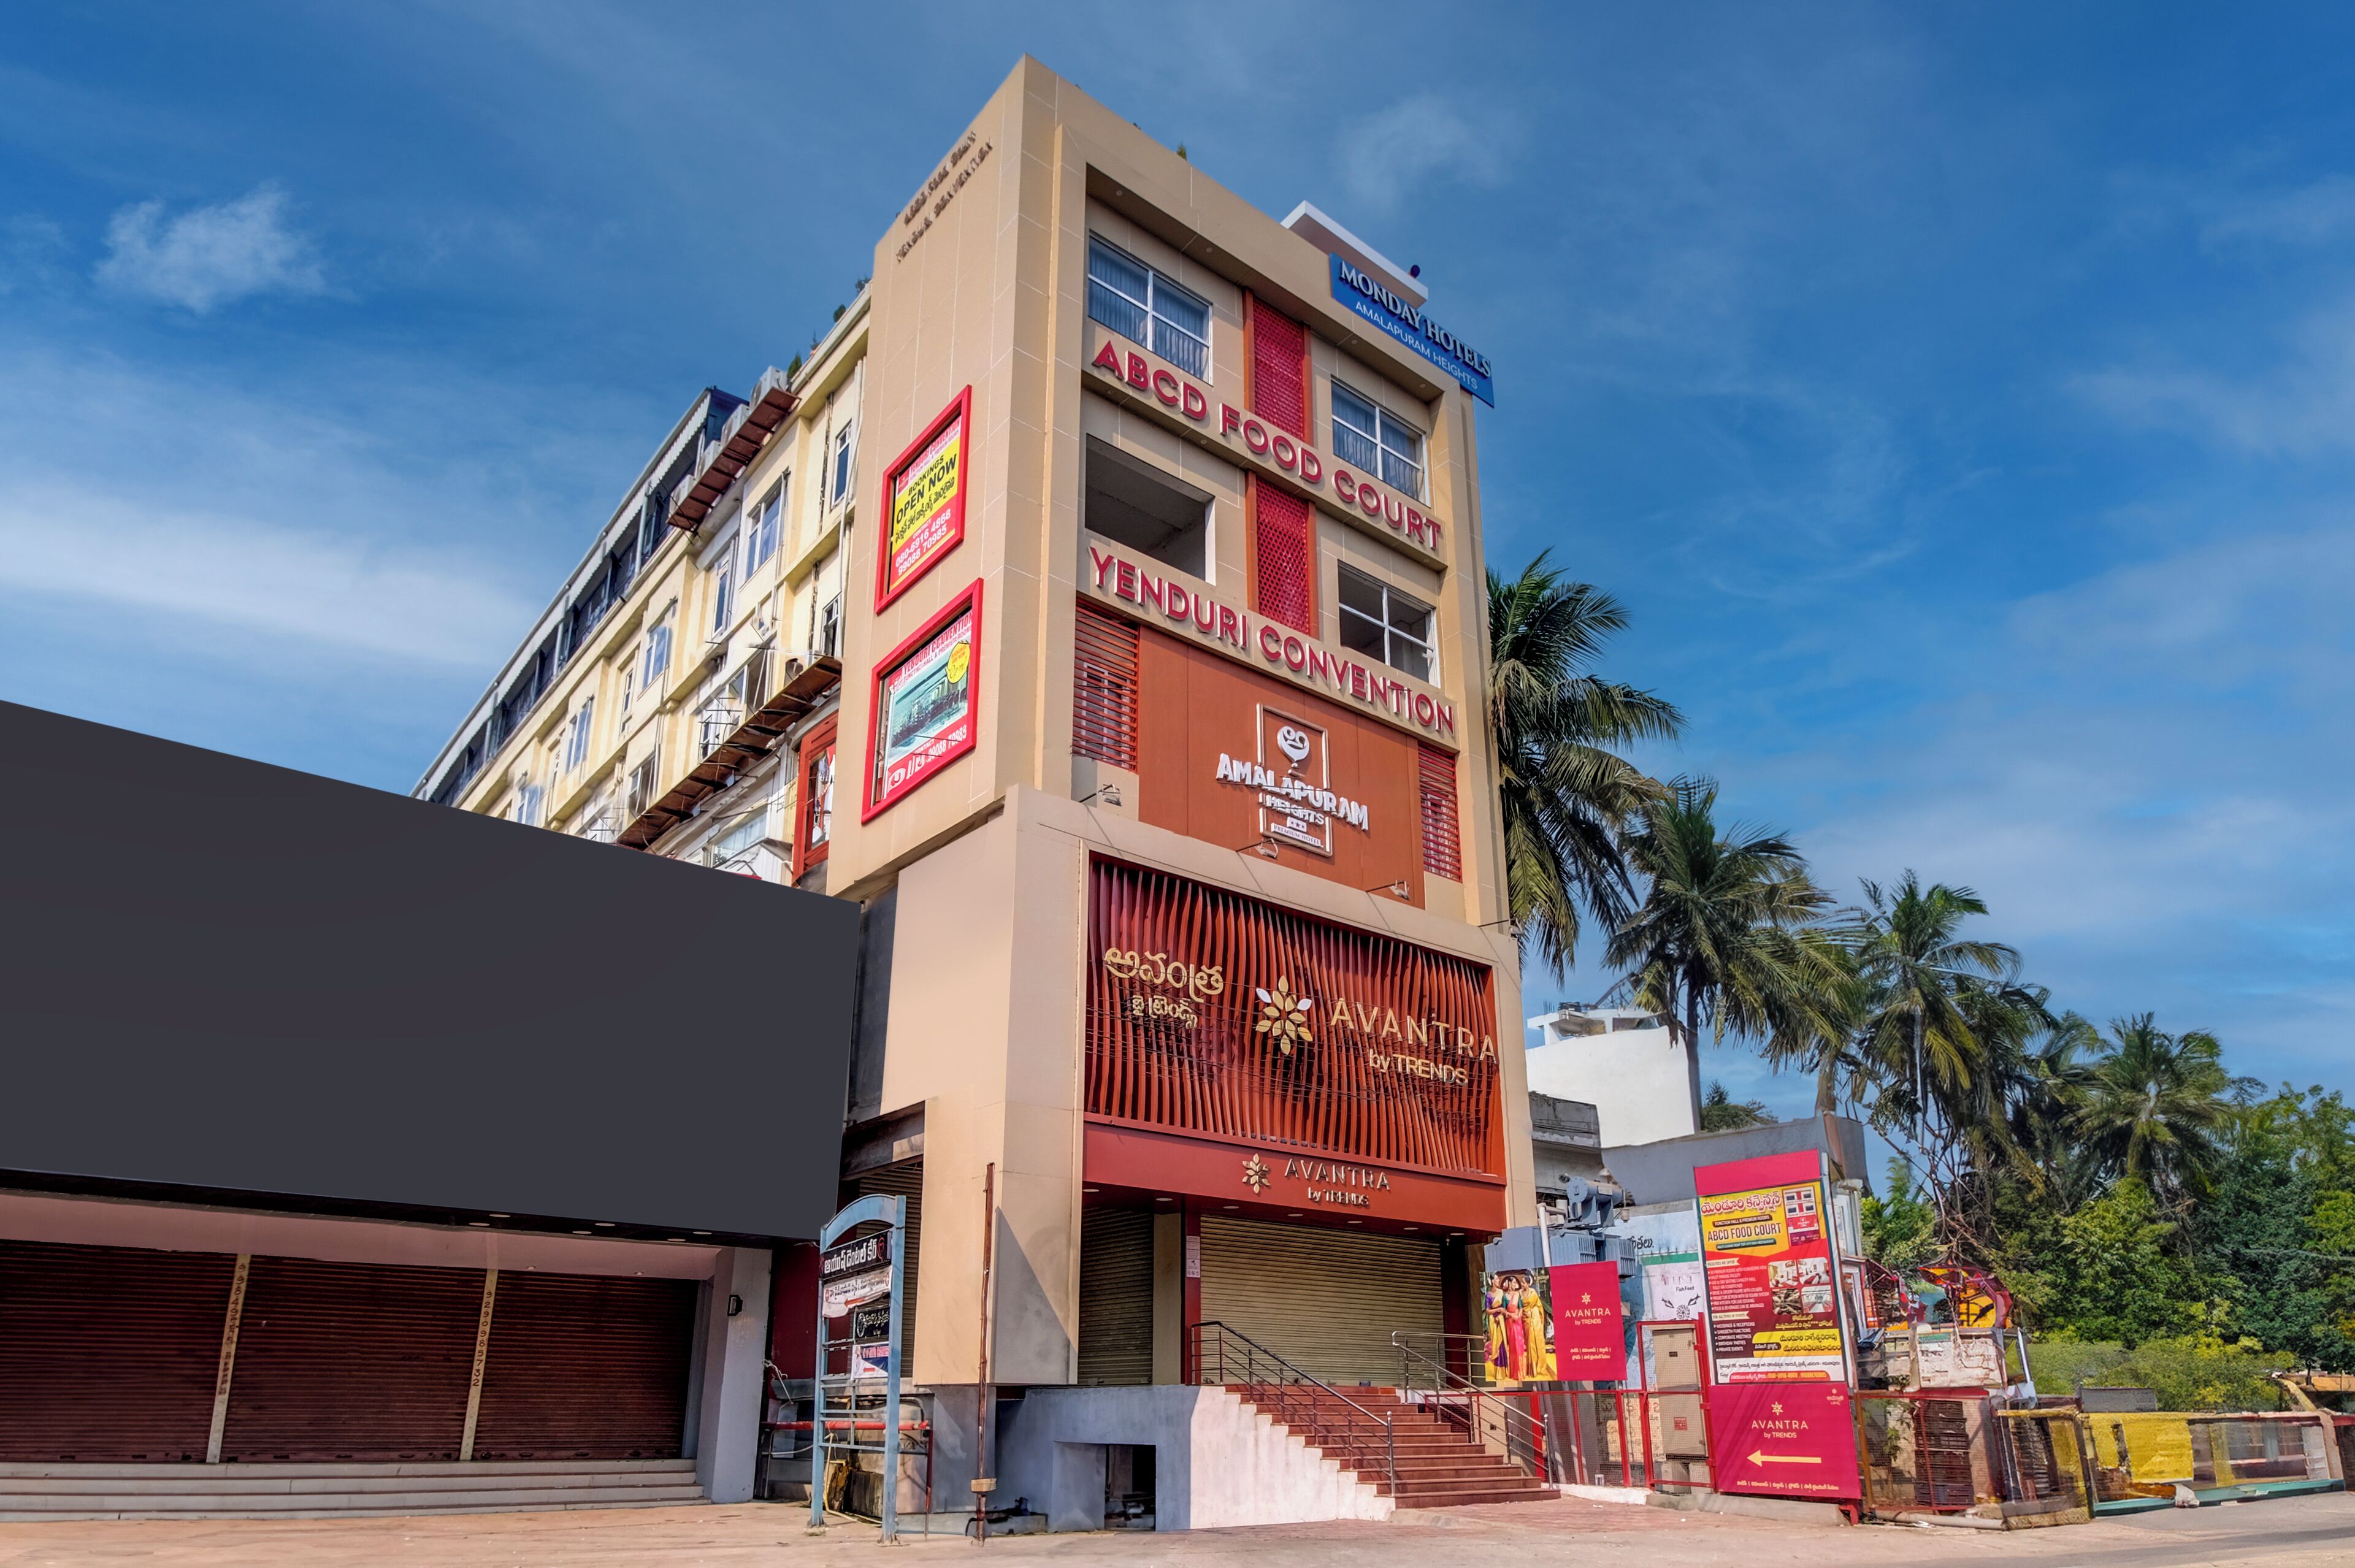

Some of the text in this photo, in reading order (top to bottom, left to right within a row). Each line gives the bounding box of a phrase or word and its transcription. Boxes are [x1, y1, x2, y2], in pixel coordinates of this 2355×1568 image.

[1339, 260, 1492, 378] MONDAY HOTELS
[1355, 300, 1478, 390] AMALAPURAM HEIGHTS
[1092, 340, 1441, 550] ABCD FOOD COURT
[897, 484, 925, 525] OPEN
[929, 453, 957, 492] NOW
[908, 454, 944, 496] BOOKINGS
[922, 524, 947, 552] 70985
[930, 508, 951, 532] 4868
[1089, 546, 1455, 736] YENDURI CONVENTION
[1216, 752, 1369, 831] AMALAPURAM
[1266, 794, 1325, 825] HEIGHTS
[1274, 824, 1320, 845] PREMIUM HOTEL
[1330, 997, 1498, 1065] AVANTRA
[1369, 1049, 1468, 1086] by TRENDS
[1284, 1158, 1391, 1190] AVANTRA
[1308, 1187, 1369, 1207] by TRENDS
[1708, 1222, 1782, 1242] ABCD FOOD COURT
[1564, 1307, 1611, 1318] AVANTRA
[472, 1291, 492, 1387] 9290985732
[1752, 1420, 1809, 1430] AVANTRA
